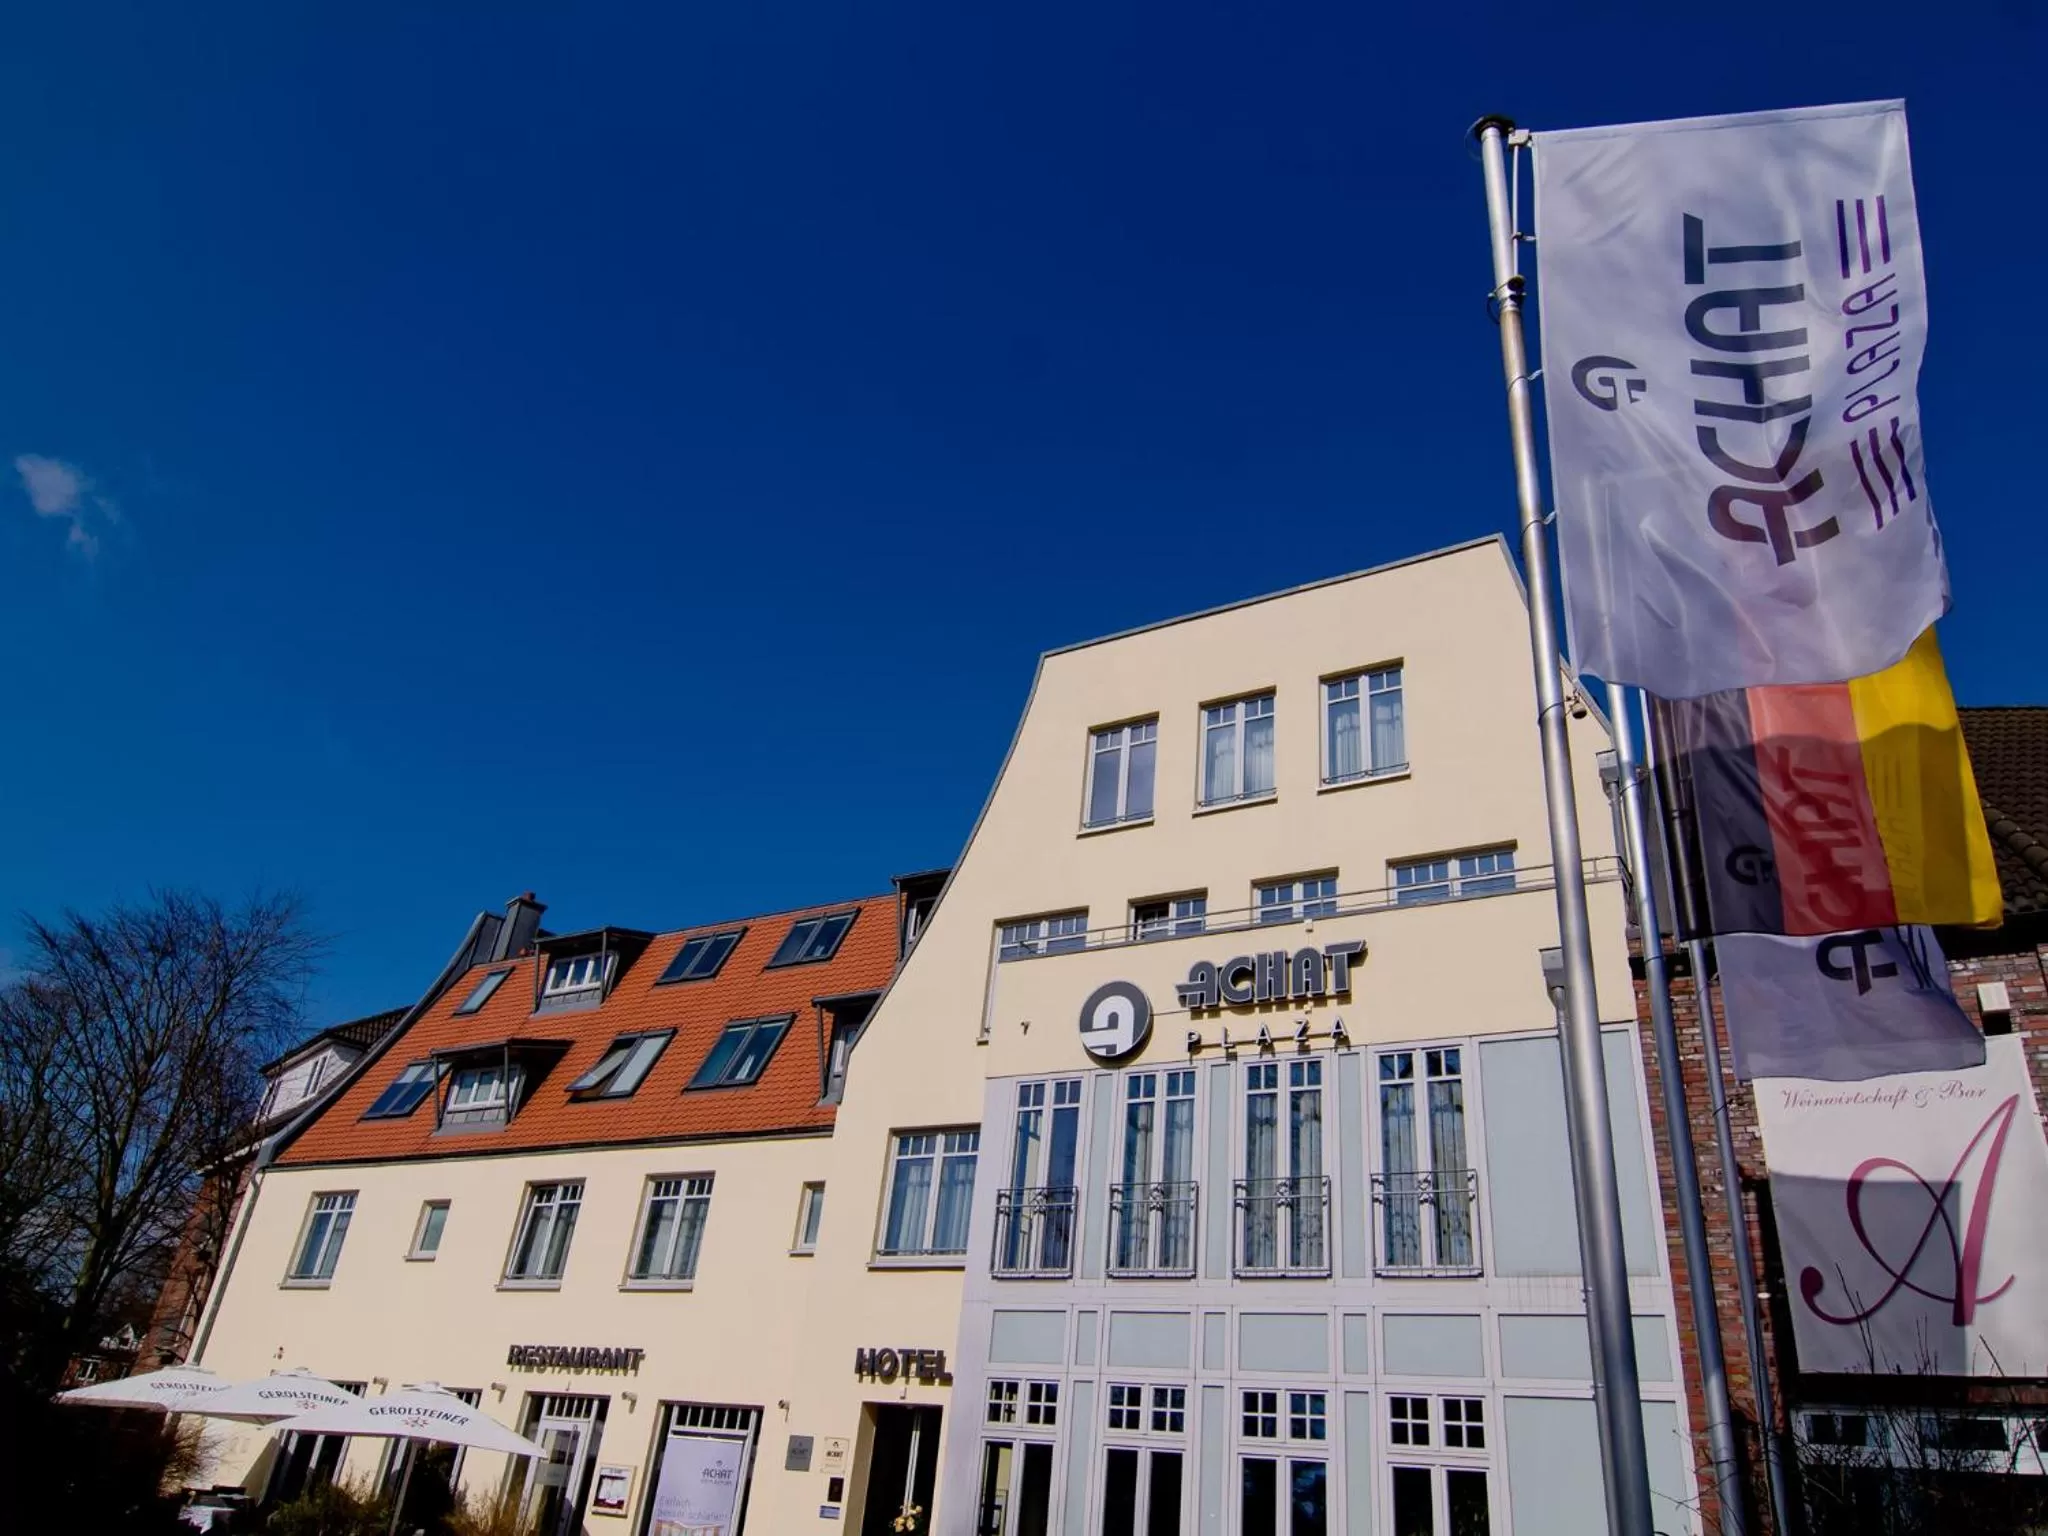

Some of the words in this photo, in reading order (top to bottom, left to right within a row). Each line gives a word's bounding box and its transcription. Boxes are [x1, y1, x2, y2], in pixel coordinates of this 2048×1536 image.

[1842, 273, 1901, 423] PLAZA
[1683, 213, 1840, 566] ACHAT
[1175, 940, 1366, 1008] ACHAT
[1186, 1016, 1351, 1051] PLAZA
[1781, 1087, 1909, 1110] Weinwirtschaft
[1915, 1084, 1935, 1108] &
[1938, 1079, 1987, 1099] Bar
[507, 1344, 645, 1371] RESTAURANT
[855, 1348, 953, 1381] HOTEL
[369, 1406, 469, 1426] GEROLSTEINER
